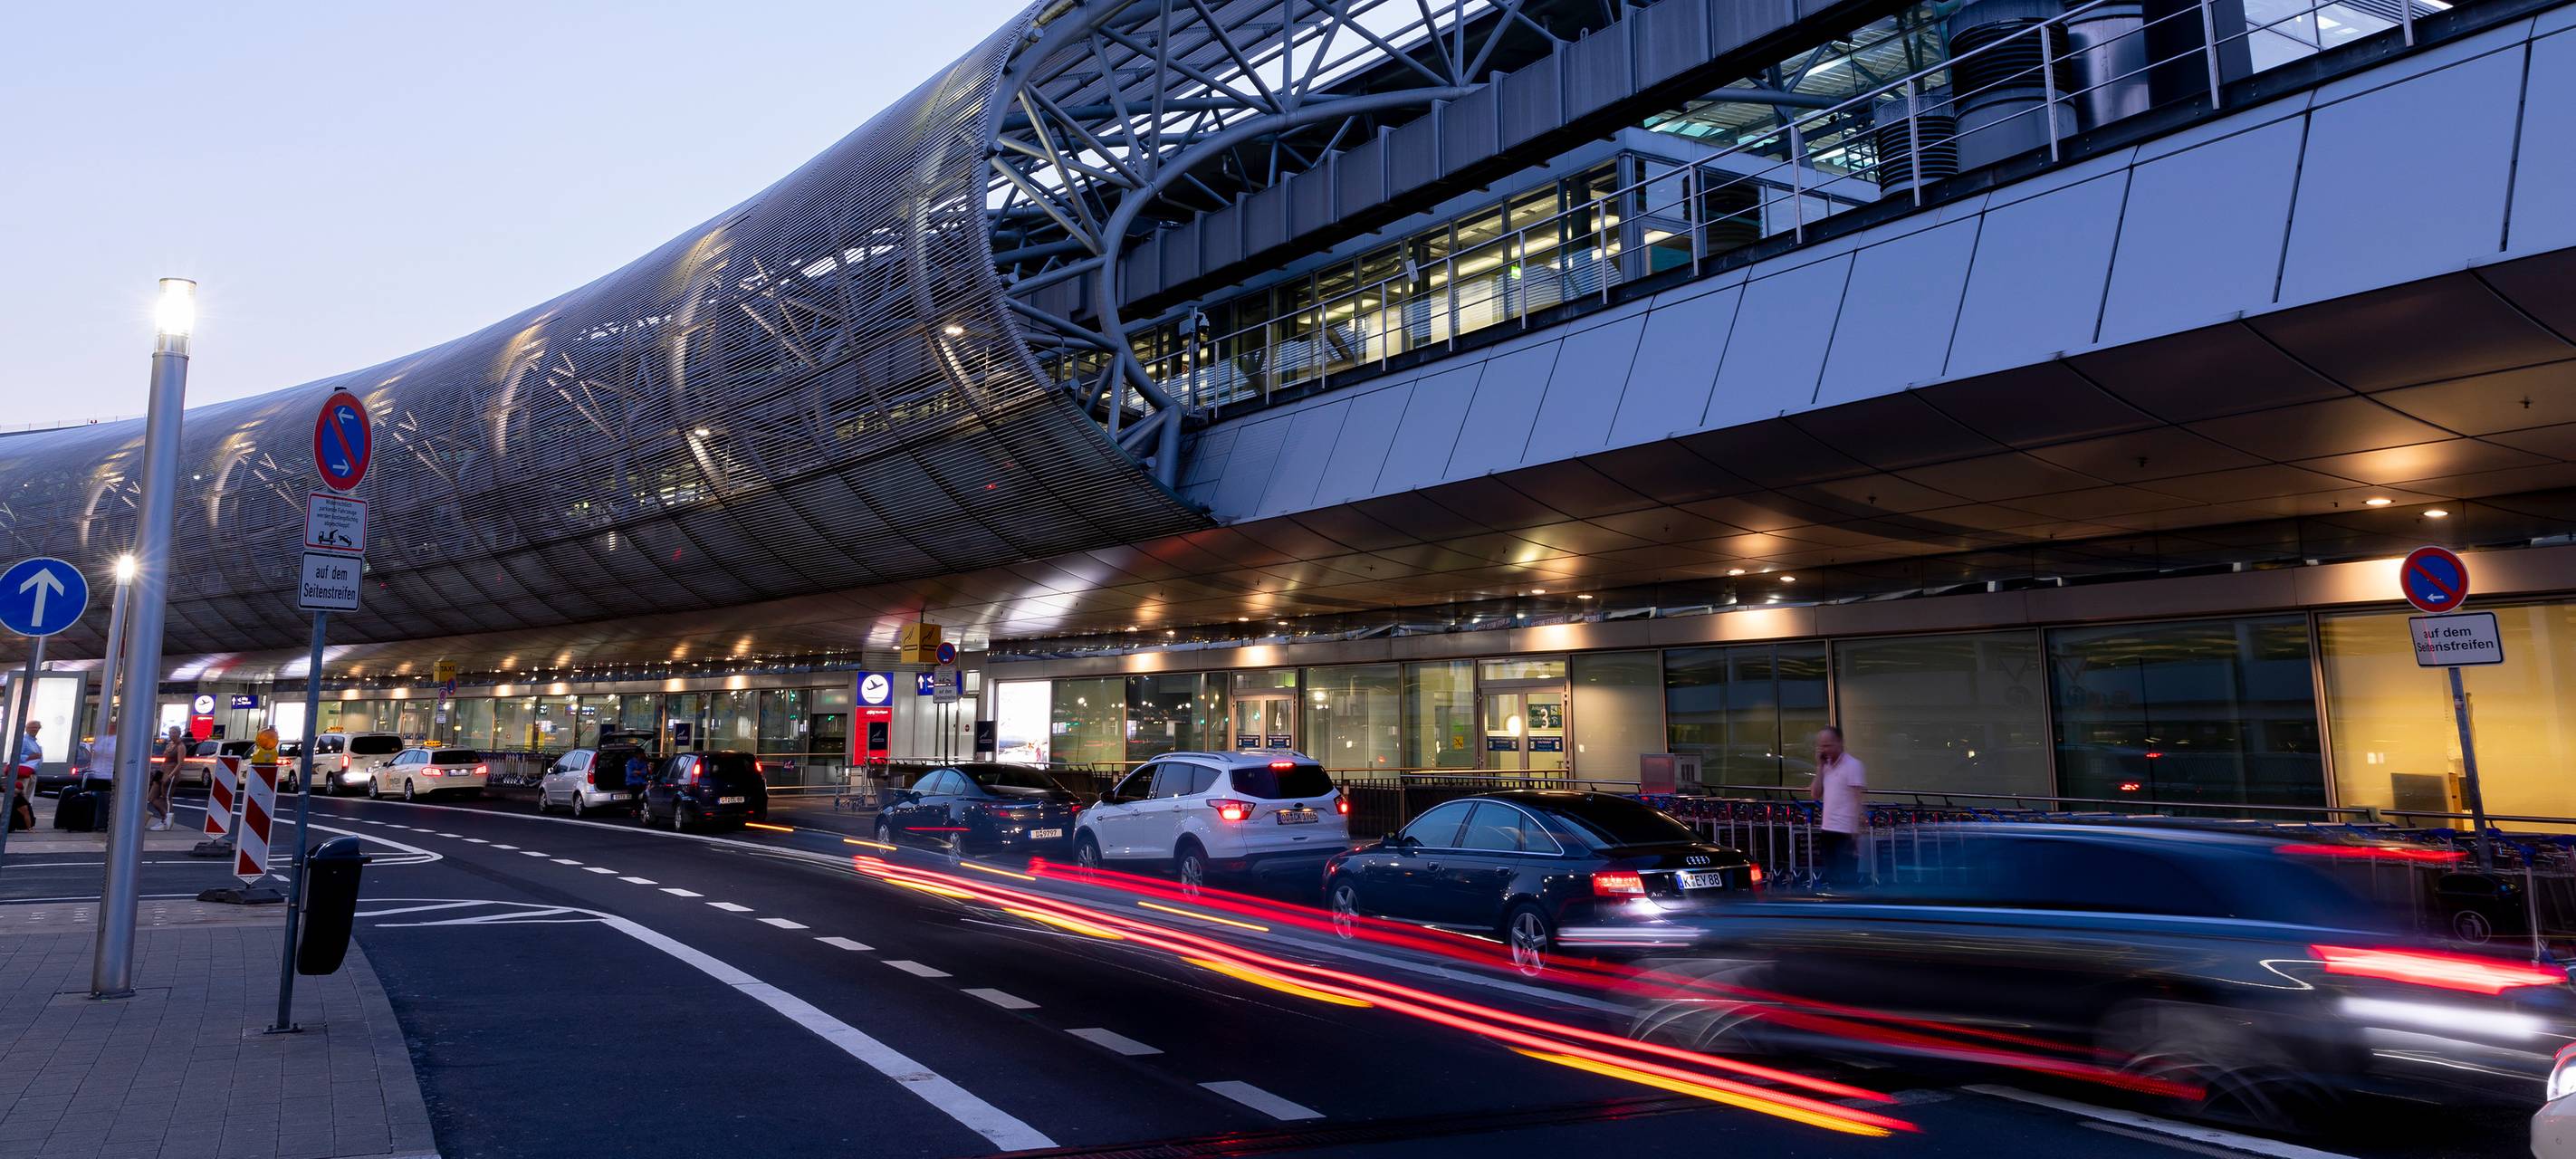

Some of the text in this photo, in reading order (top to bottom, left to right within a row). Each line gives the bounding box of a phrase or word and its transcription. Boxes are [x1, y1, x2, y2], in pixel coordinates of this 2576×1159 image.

[316, 565, 348, 580] auf dem
[303, 582, 356, 600] Seitenstreifen
[2423, 627, 2472, 638] auf dem
[2417, 639, 2495, 652] Seitenstreifen
[1275, 712, 1282, 730] 4
[1540, 708, 1549, 730] 3
[1683, 873, 1720, 887] K EY 88
